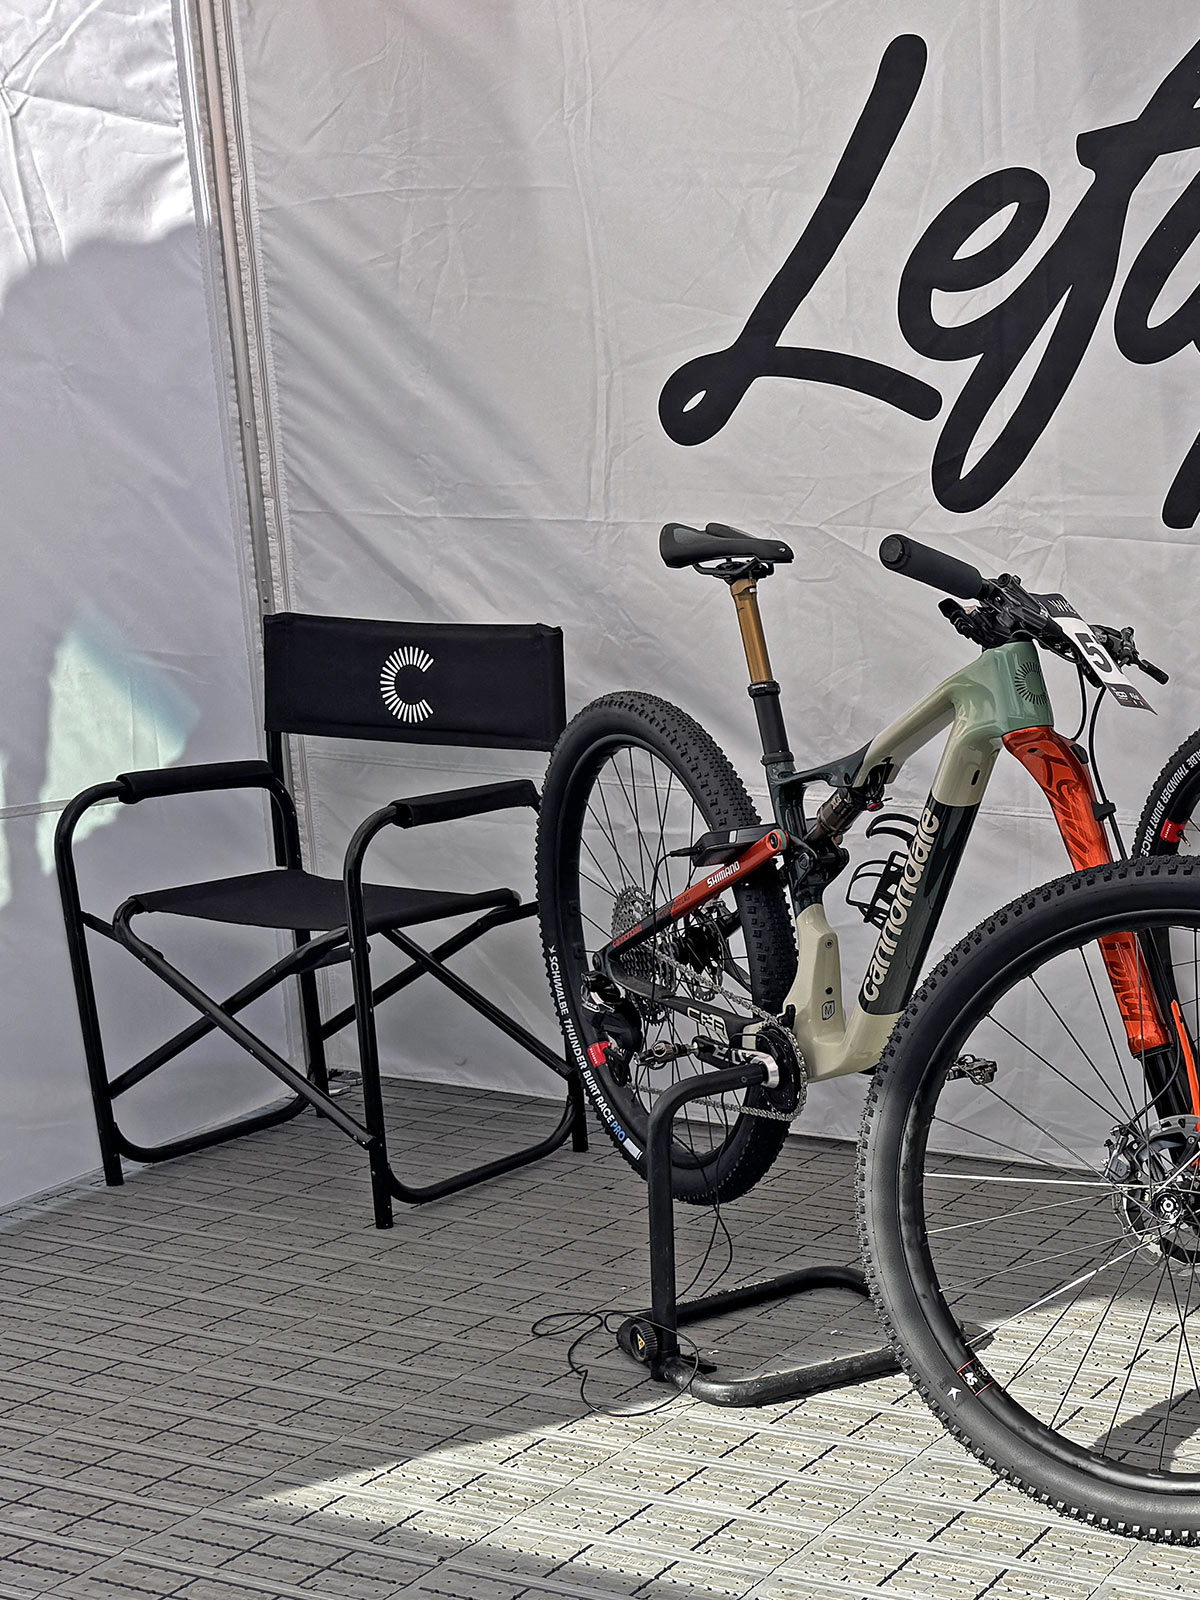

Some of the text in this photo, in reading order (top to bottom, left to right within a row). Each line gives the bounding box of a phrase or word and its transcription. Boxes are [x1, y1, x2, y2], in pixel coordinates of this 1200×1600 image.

[1074, 632, 1113, 673] 5
[1160, 763, 1189, 804] THUNDER
[1150, 800, 1166, 830] BURT
[1141, 824, 1156, 857] RACE
[707, 861, 740, 888] SHIMANO
[863, 808, 940, 1002] cannondale
[549, 956, 569, 1016] SCHWALBE
[563, 1018, 588, 1070] THUNDER
[582, 1070, 601, 1097] BURT
[595, 1092, 615, 1124] RACE
[610, 1120, 627, 1142] PRO
